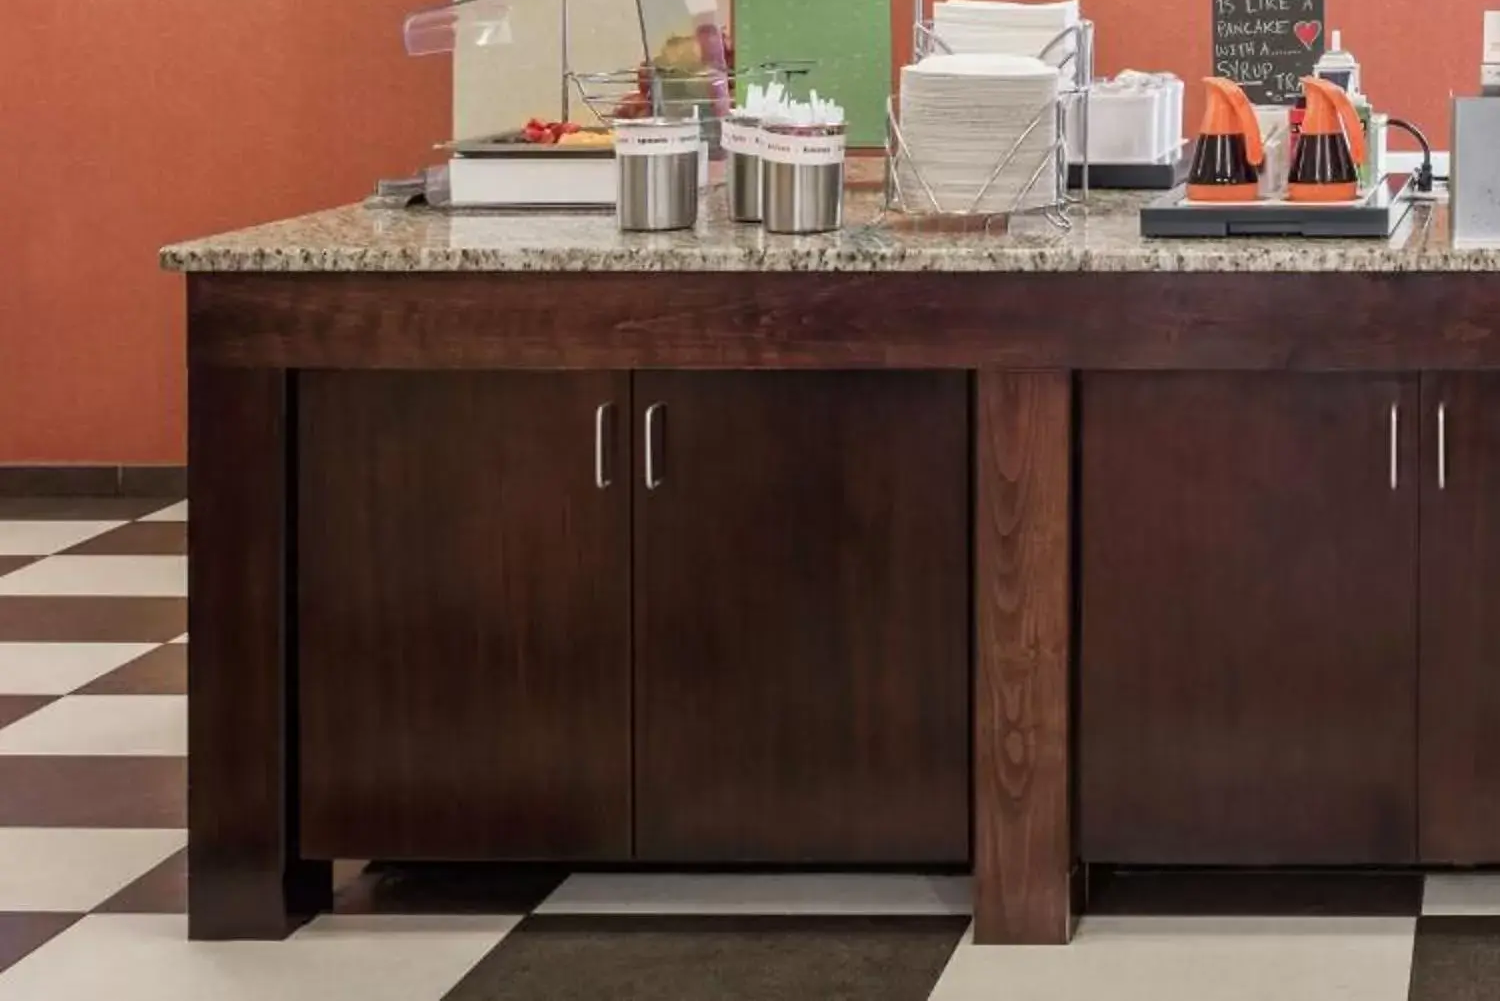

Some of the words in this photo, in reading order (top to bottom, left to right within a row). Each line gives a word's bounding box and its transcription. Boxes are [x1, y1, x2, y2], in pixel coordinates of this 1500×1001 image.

[1217, 19, 1290, 38] PANCAKE
[1215, 41, 1256, 58] WITH
[1216, 59, 1274, 81] SYRUP
[1275, 72, 1305, 92] TRA
